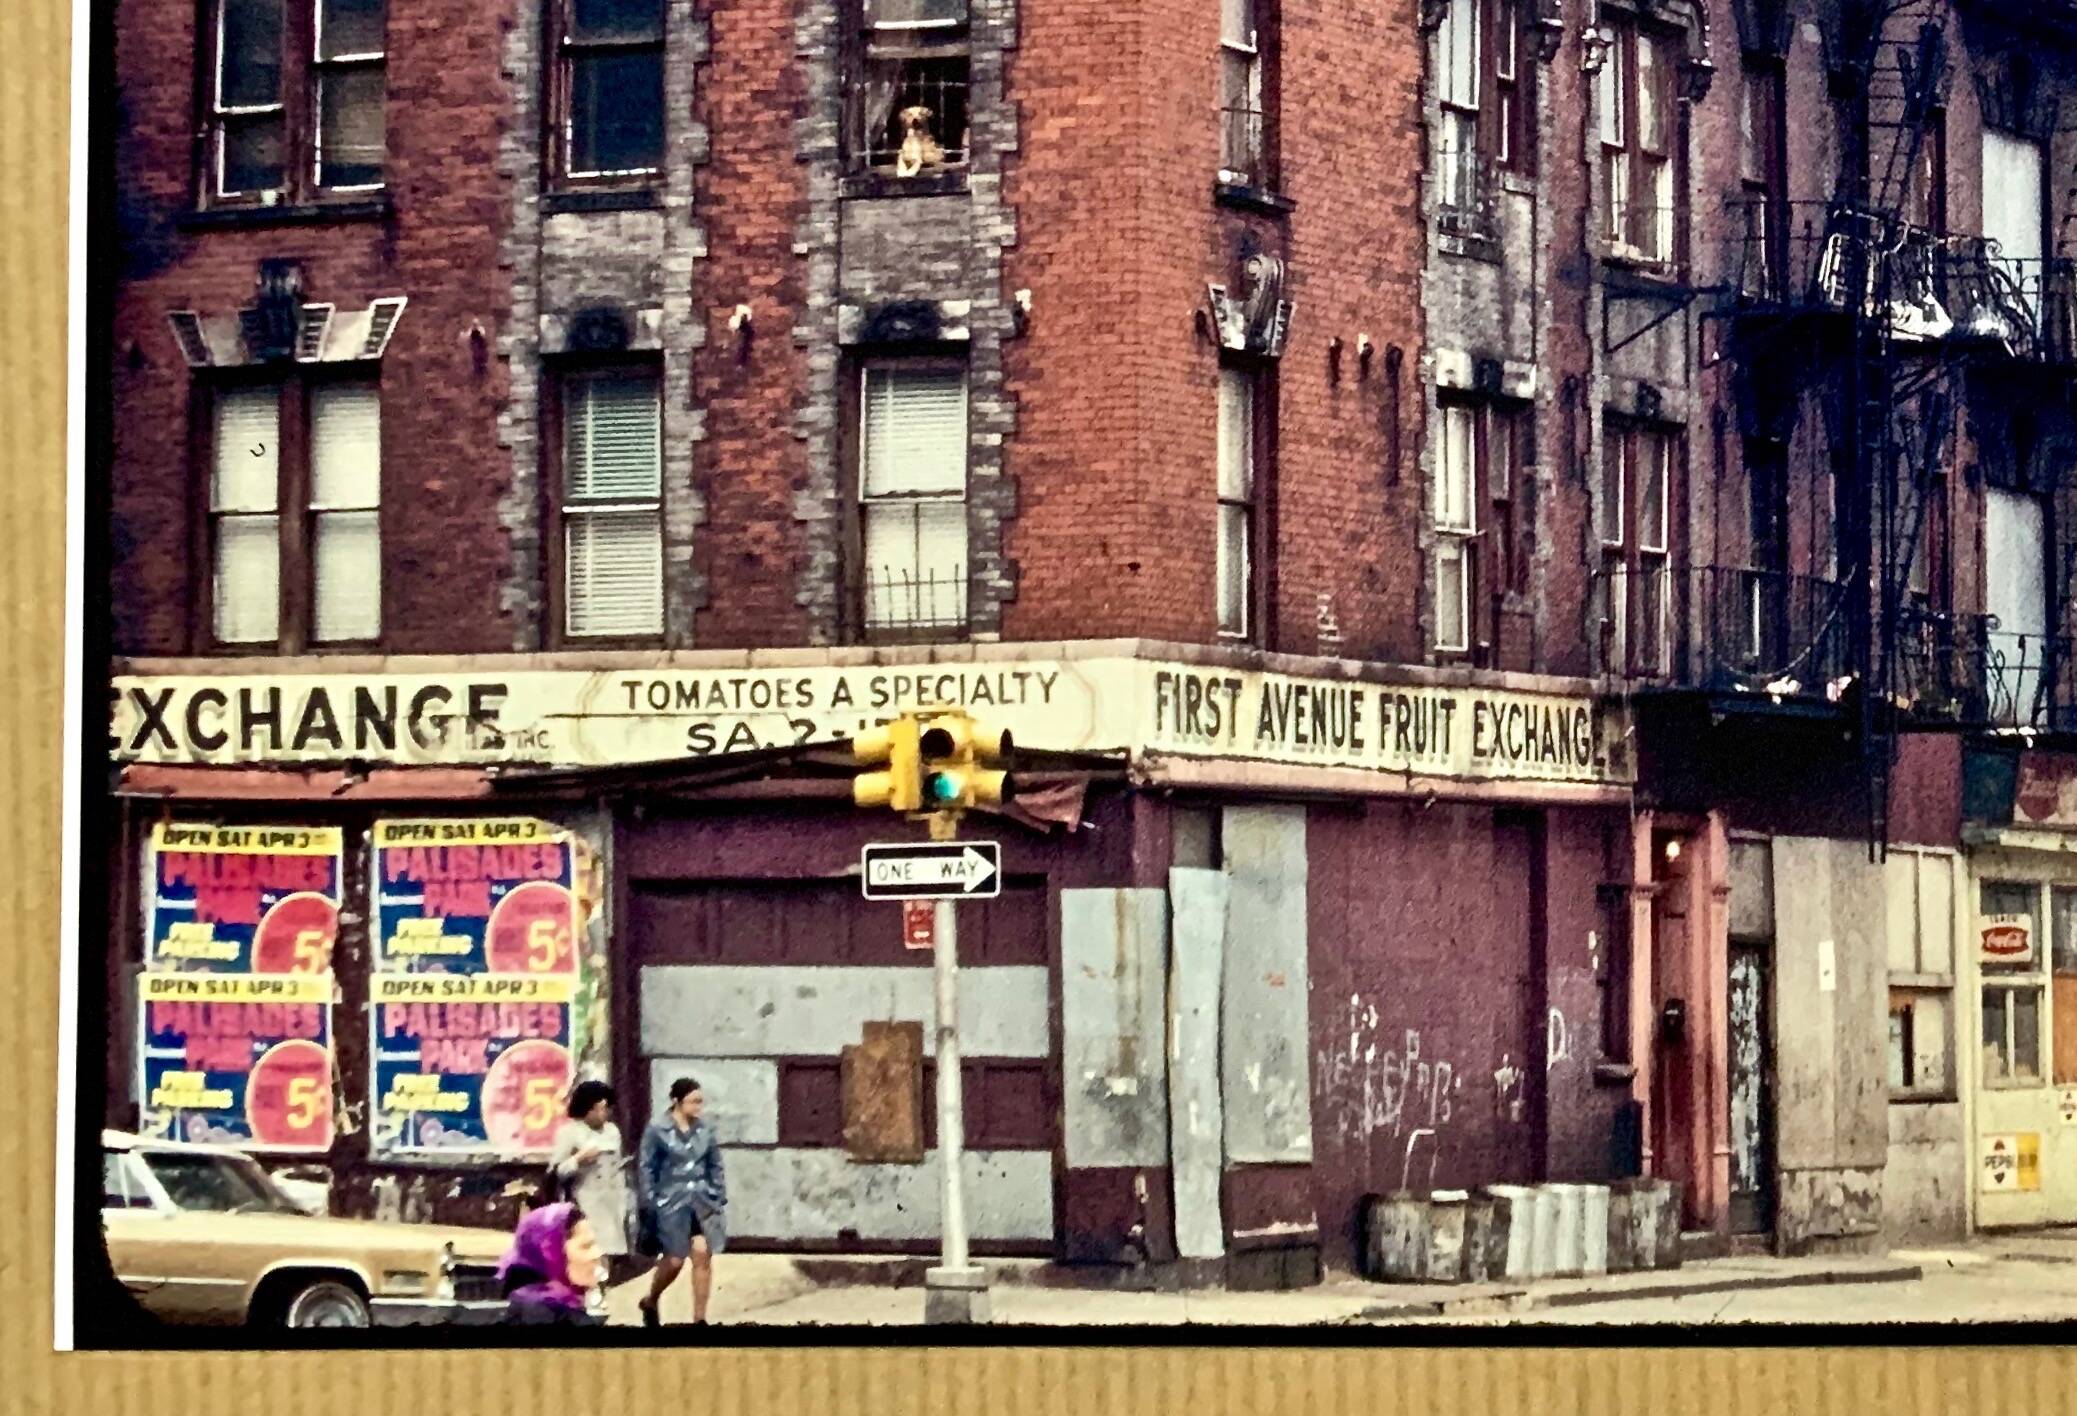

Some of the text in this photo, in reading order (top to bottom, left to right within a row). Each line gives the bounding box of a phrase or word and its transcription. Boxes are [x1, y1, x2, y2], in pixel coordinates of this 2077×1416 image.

[622, 671, 1058, 711] TOMATOES A SPECIALTY
[1154, 671, 1243, 739] FIRST
[1256, 681, 1366, 750] AVENUE
[1378, 691, 1457, 756] FRUIT
[163, 830, 212, 847] OPEN
[217, 830, 252, 848] SAT
[384, 822, 538, 841] OPEN SAT APR 3
[876, 859, 980, 882] ONE WAY
[382, 979, 538, 996] OPEN SAT APR 3
